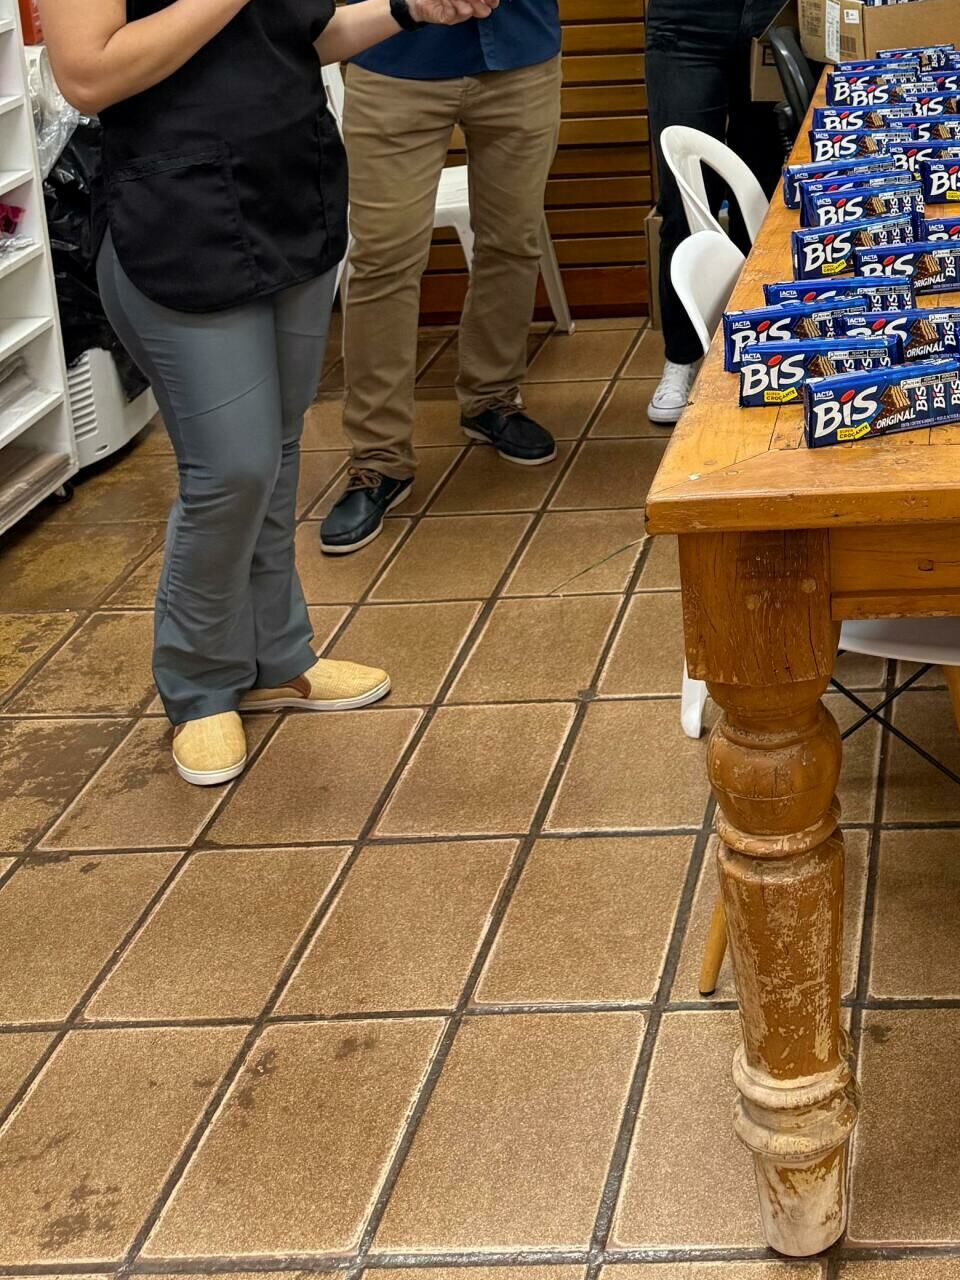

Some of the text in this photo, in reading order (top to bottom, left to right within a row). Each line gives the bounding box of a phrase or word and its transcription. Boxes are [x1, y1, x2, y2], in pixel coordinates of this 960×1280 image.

[914, 273, 945, 289] ORIGINAL
[780, 290, 797, 298] LACTA
[732, 321, 750, 329] LACTA
[848, 317, 866, 325] LACTA
[907, 342, 944, 357] ORIGINAL
[742, 353, 760, 362] LACTA
[814, 390, 834, 401] LACTA
[877, 408, 916, 429] ORIGINAL
